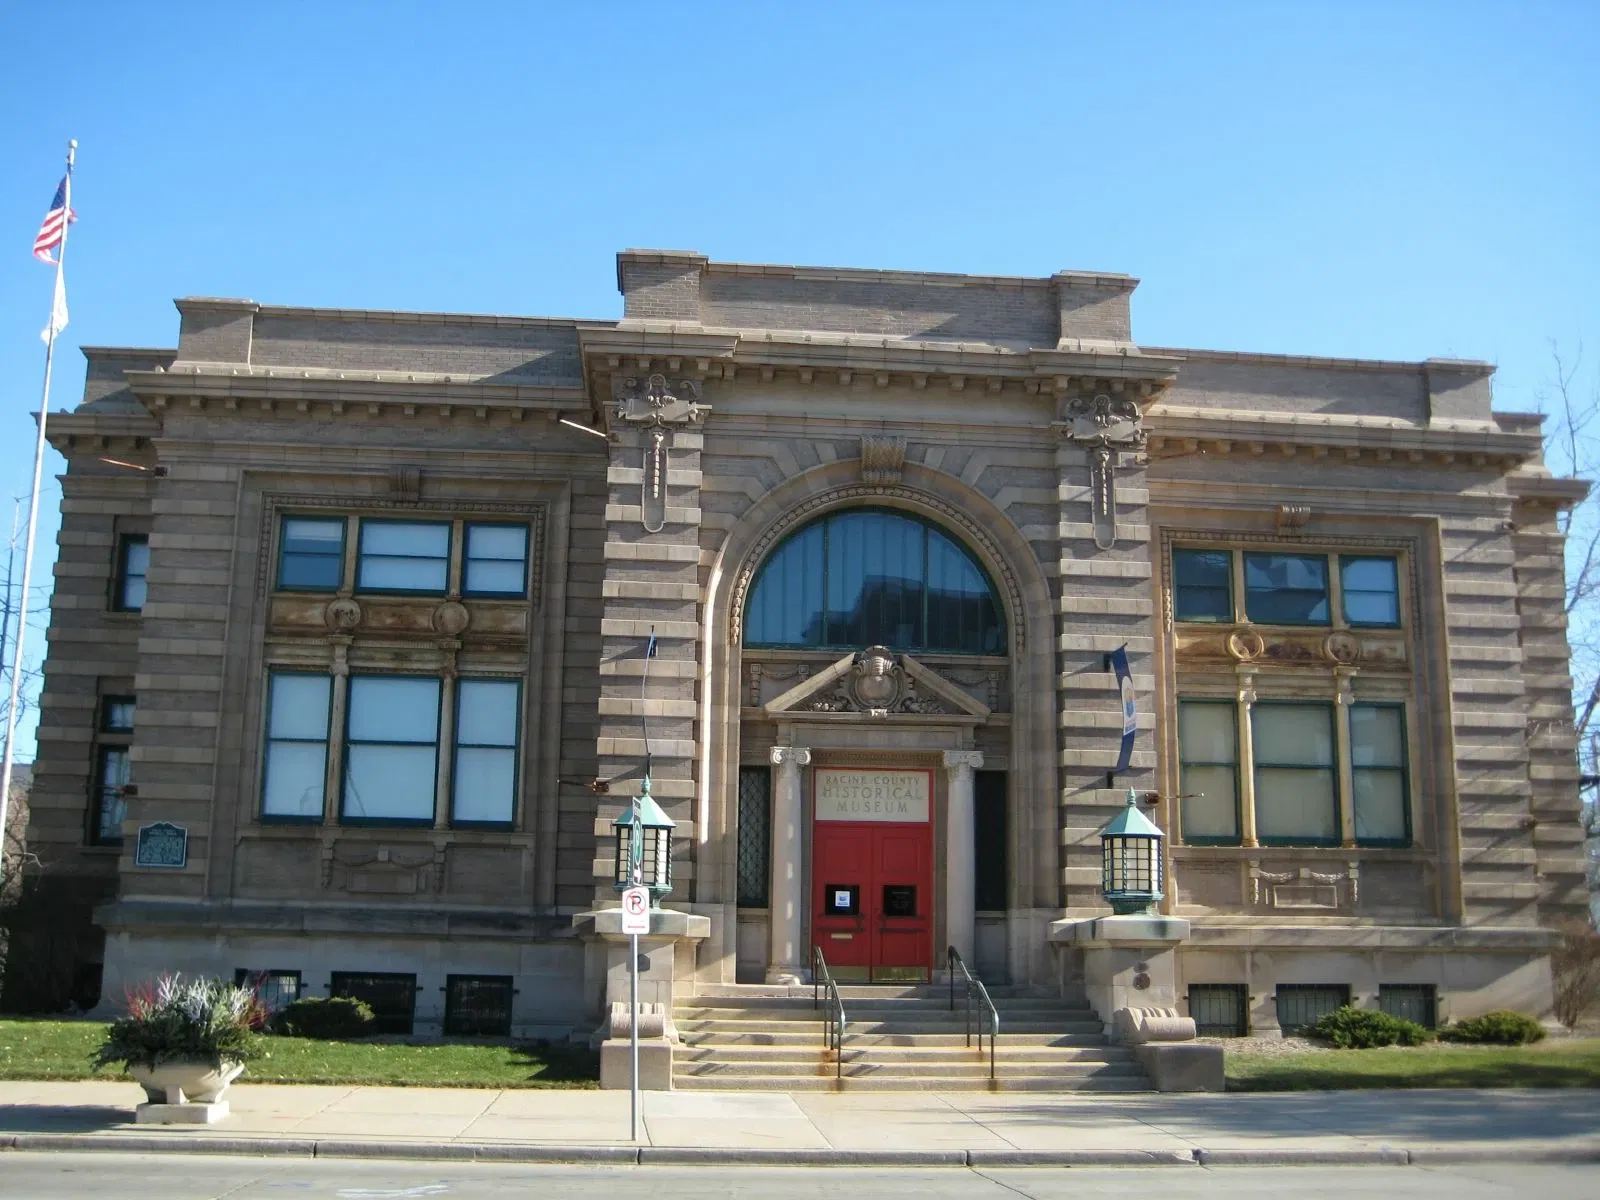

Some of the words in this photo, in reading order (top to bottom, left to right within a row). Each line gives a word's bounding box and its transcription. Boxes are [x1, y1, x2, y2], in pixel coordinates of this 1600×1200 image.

[826, 775, 867, 785] RACINE
[873, 776, 920, 785] COUNTY
[823, 787, 922, 800] HISTORICAL
[837, 801, 908, 813] MUSEUM
[631, 895, 642, 911] P
